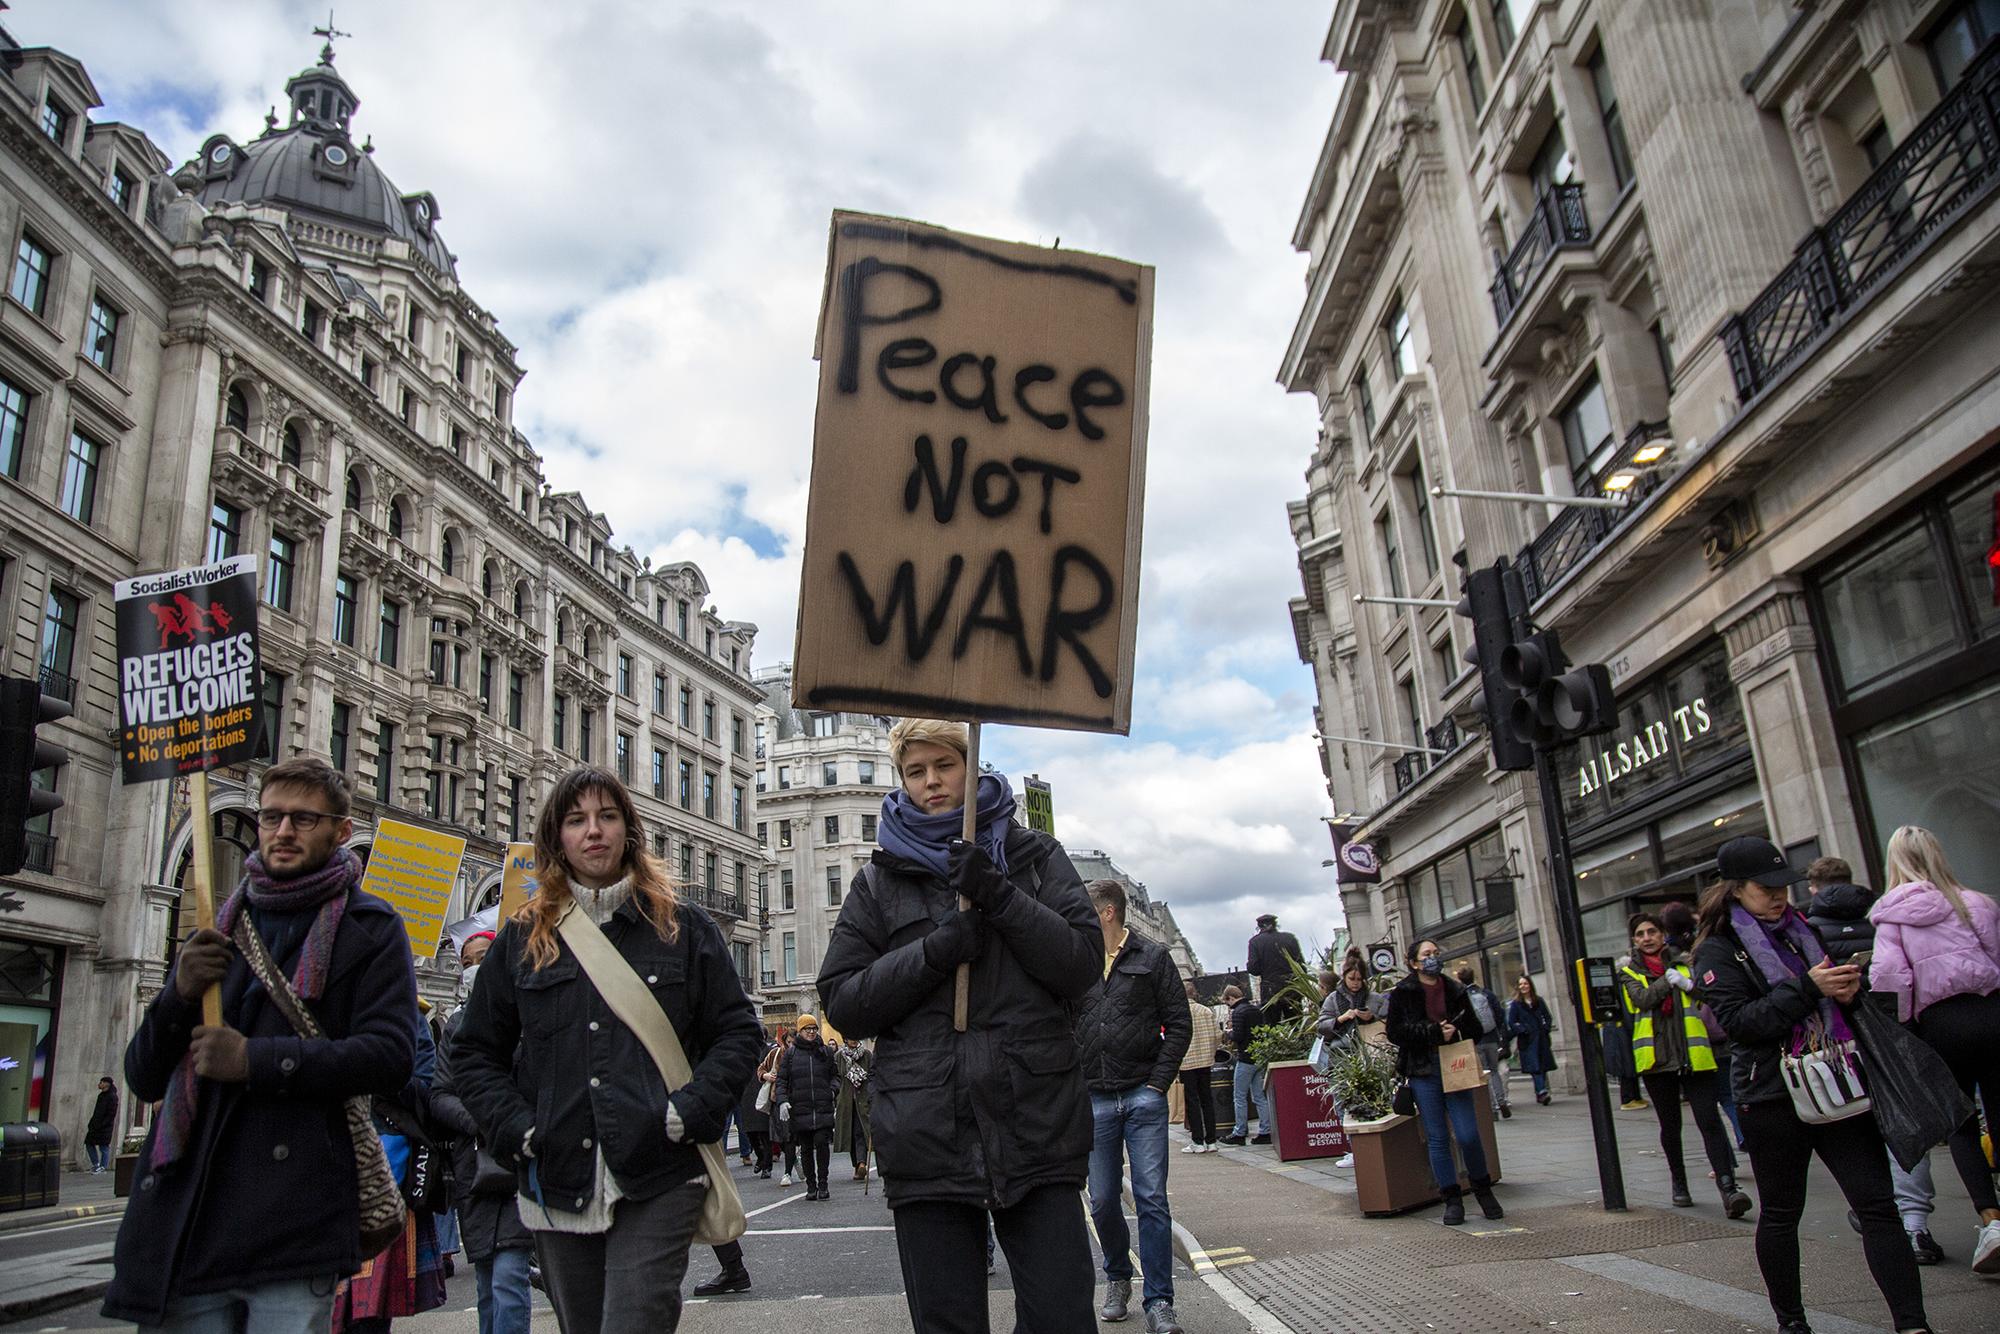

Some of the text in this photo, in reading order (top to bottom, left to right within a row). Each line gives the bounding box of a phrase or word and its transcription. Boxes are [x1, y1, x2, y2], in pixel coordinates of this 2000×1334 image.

[838, 257, 1126, 440] Peace
[837, 545, 1114, 698] WAR
[123, 632, 254, 692] REFUGEES
[123, 666, 255, 726] WELCOME
[138, 707, 253, 745] Open the borders
[139, 728, 246, 763] No deportations
[1026, 790, 1040, 811] NO
[1306, 1119, 1338, 1129] brought
[1316, 1132, 1342, 1140] CROWN
[1317, 1138, 1342, 1146] ESTATE
